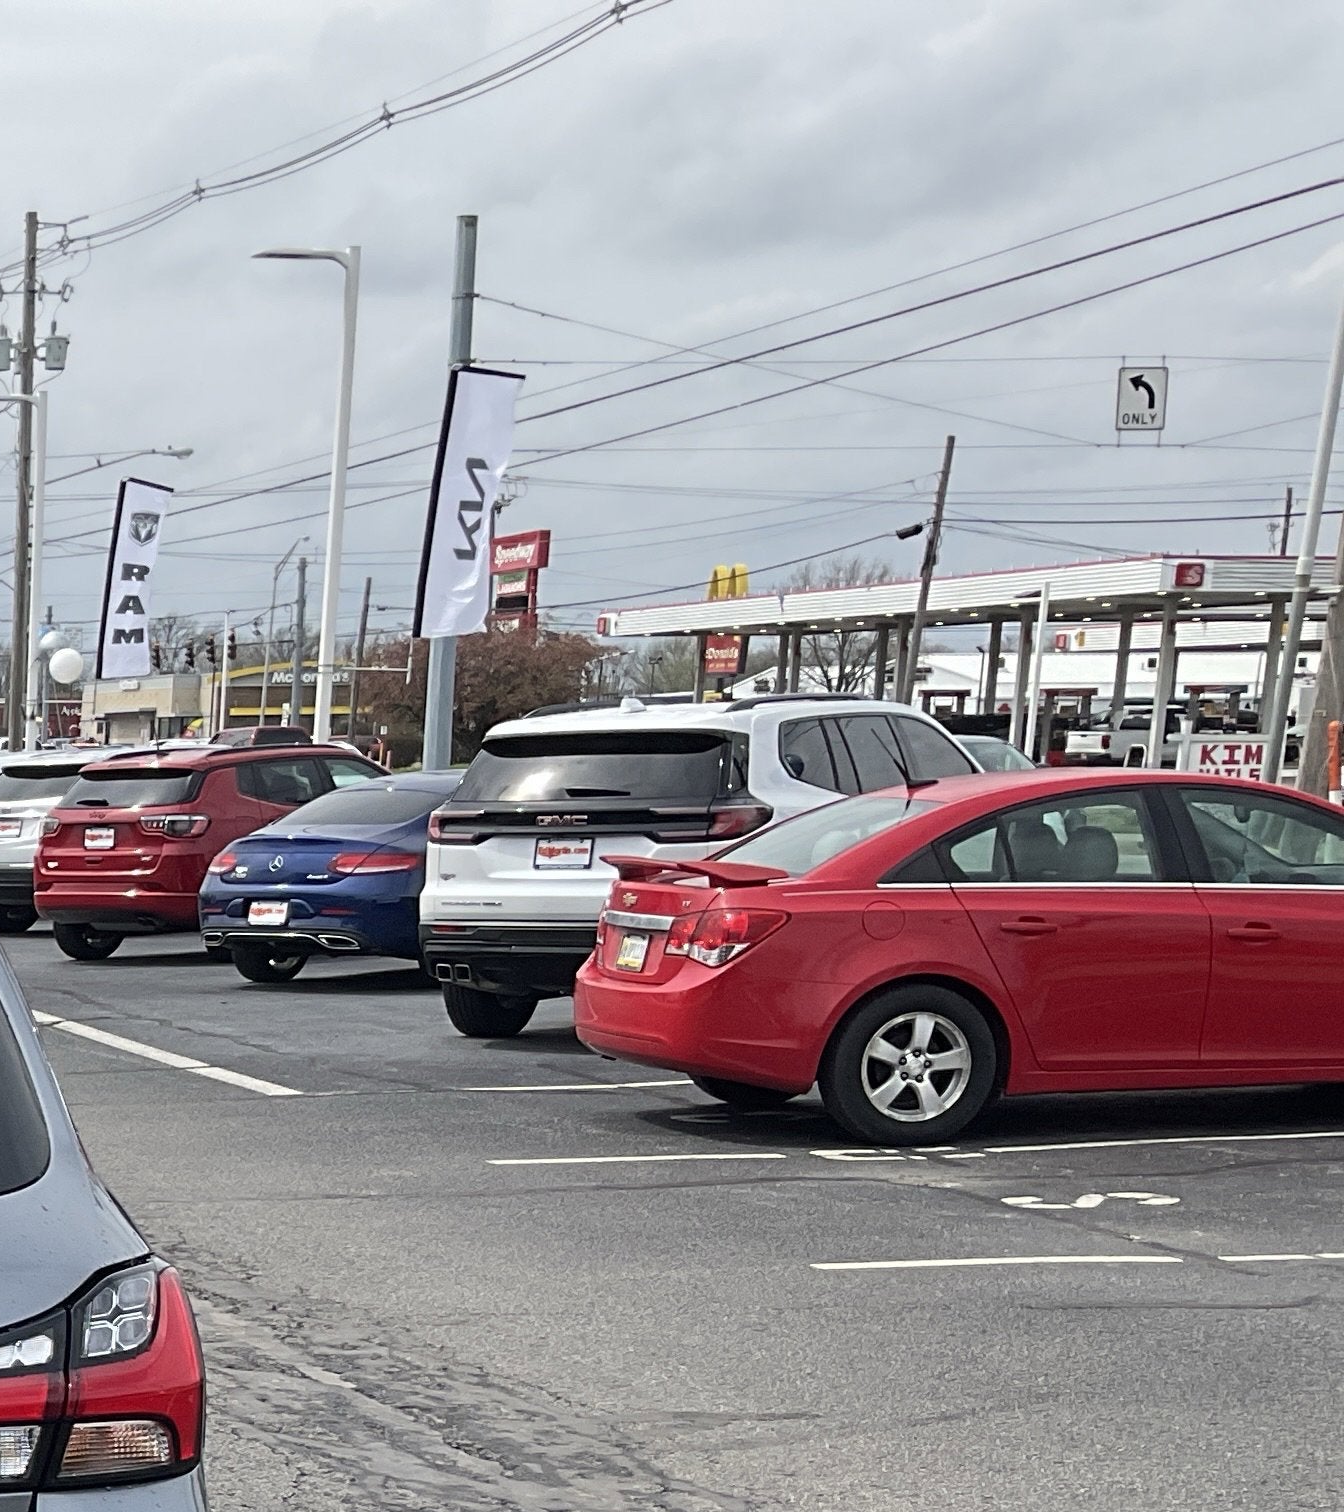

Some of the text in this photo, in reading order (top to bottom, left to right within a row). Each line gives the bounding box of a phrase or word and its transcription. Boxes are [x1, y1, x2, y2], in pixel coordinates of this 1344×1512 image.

[1122, 413, 1157, 425] ONLY
[112, 563, 150, 644] RAM
[1200, 745, 1263, 765] KIM
[537, 815, 588, 826] GMC
